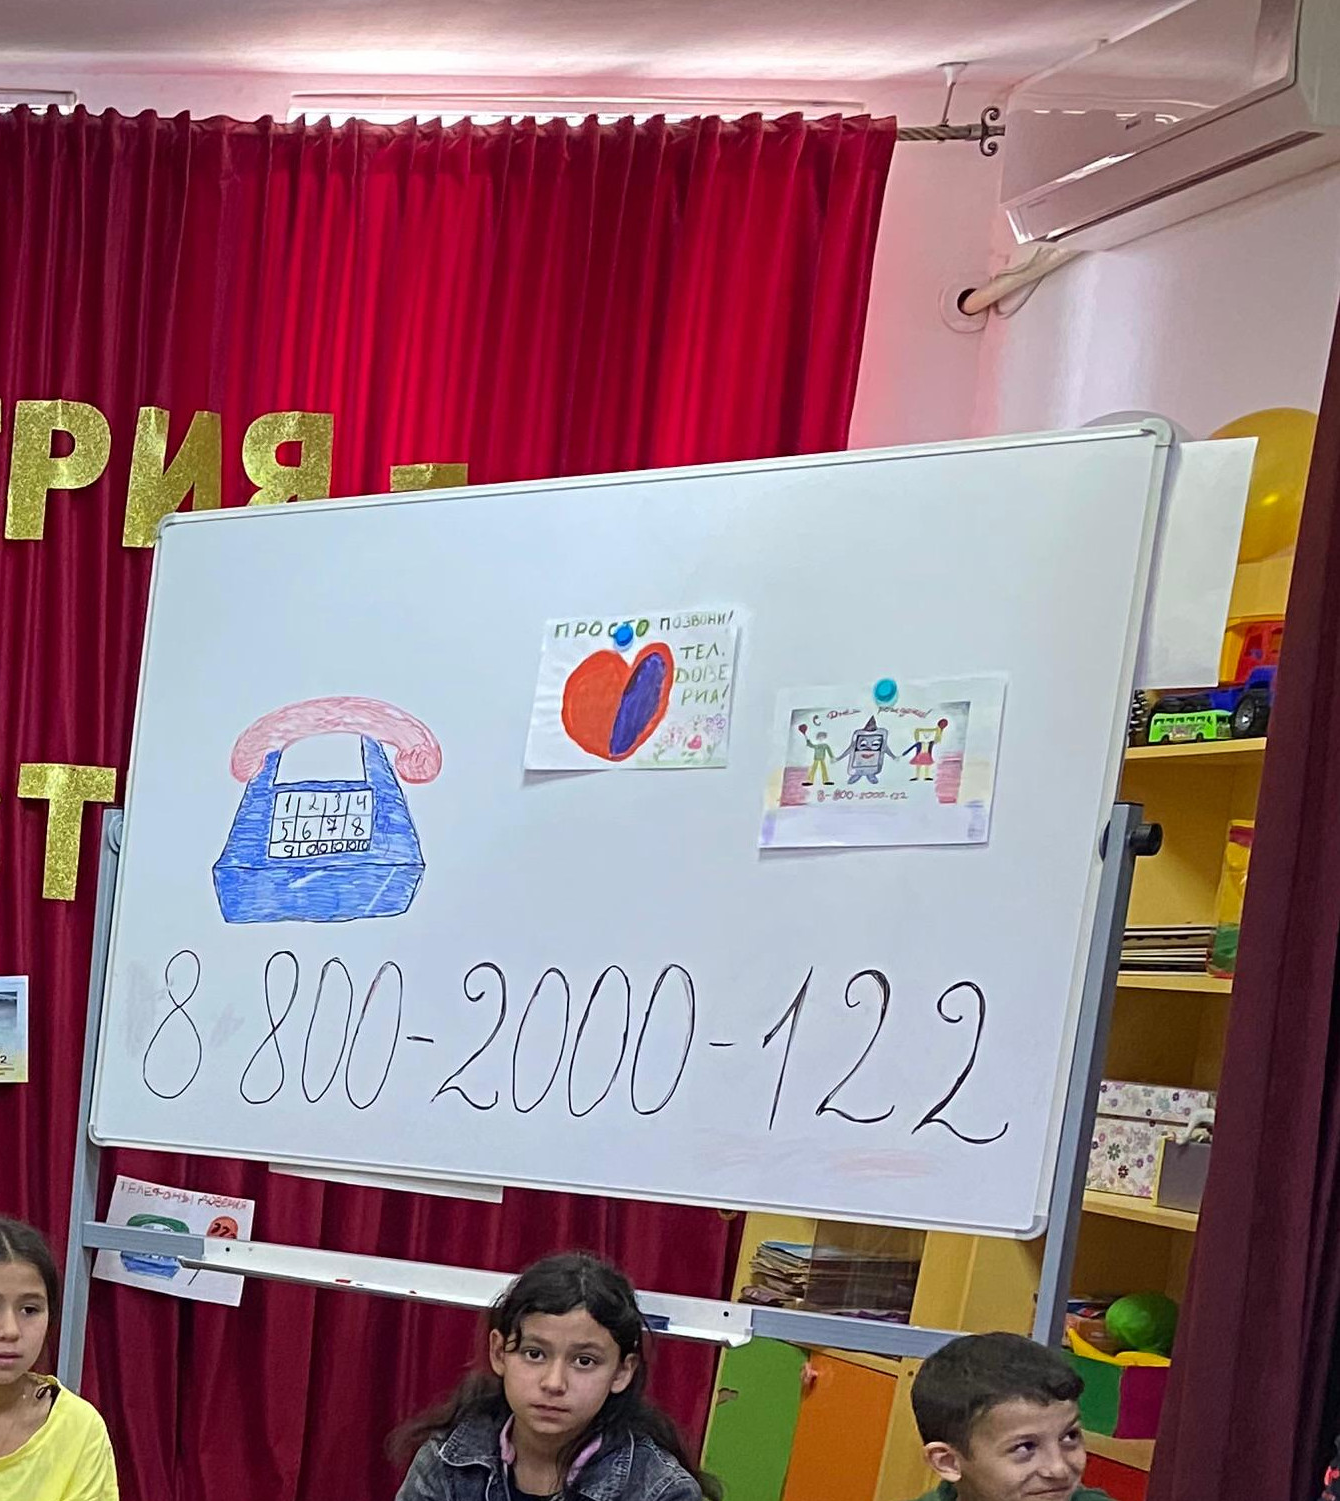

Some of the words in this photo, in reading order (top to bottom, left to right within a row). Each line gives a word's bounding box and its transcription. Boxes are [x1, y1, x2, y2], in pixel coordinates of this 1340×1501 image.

[309, 793, 319, 811] 2
[356, 794, 368, 811] 4
[281, 820, 293, 841] 5
[302, 820, 312, 840] 6
[326, 816, 337, 836] 7
[351, 816, 365, 837] 8
[141, 949, 202, 1099] 8
[239, 949, 1009, 1145] 800-2000-122
